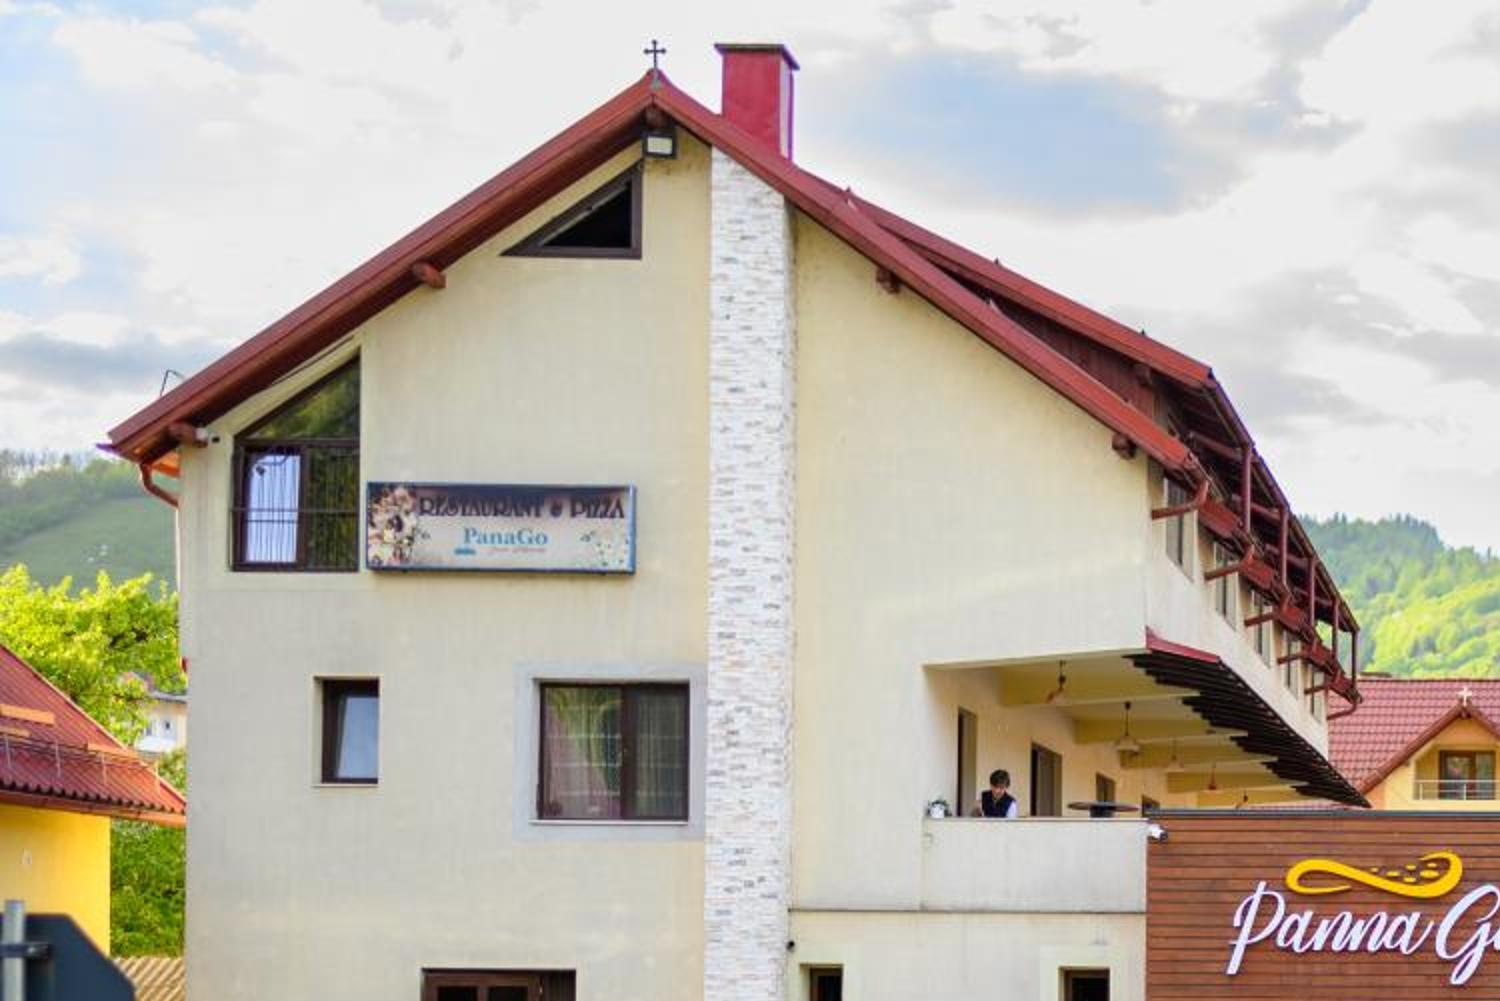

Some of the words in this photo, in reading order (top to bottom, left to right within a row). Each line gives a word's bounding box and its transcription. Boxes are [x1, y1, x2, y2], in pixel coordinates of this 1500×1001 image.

[418, 496, 542, 518] RESTAURANT
[570, 496, 625, 518] PIZZA
[463, 527, 549, 545] PanaGo
[1225, 880, 1435, 976] Panna
